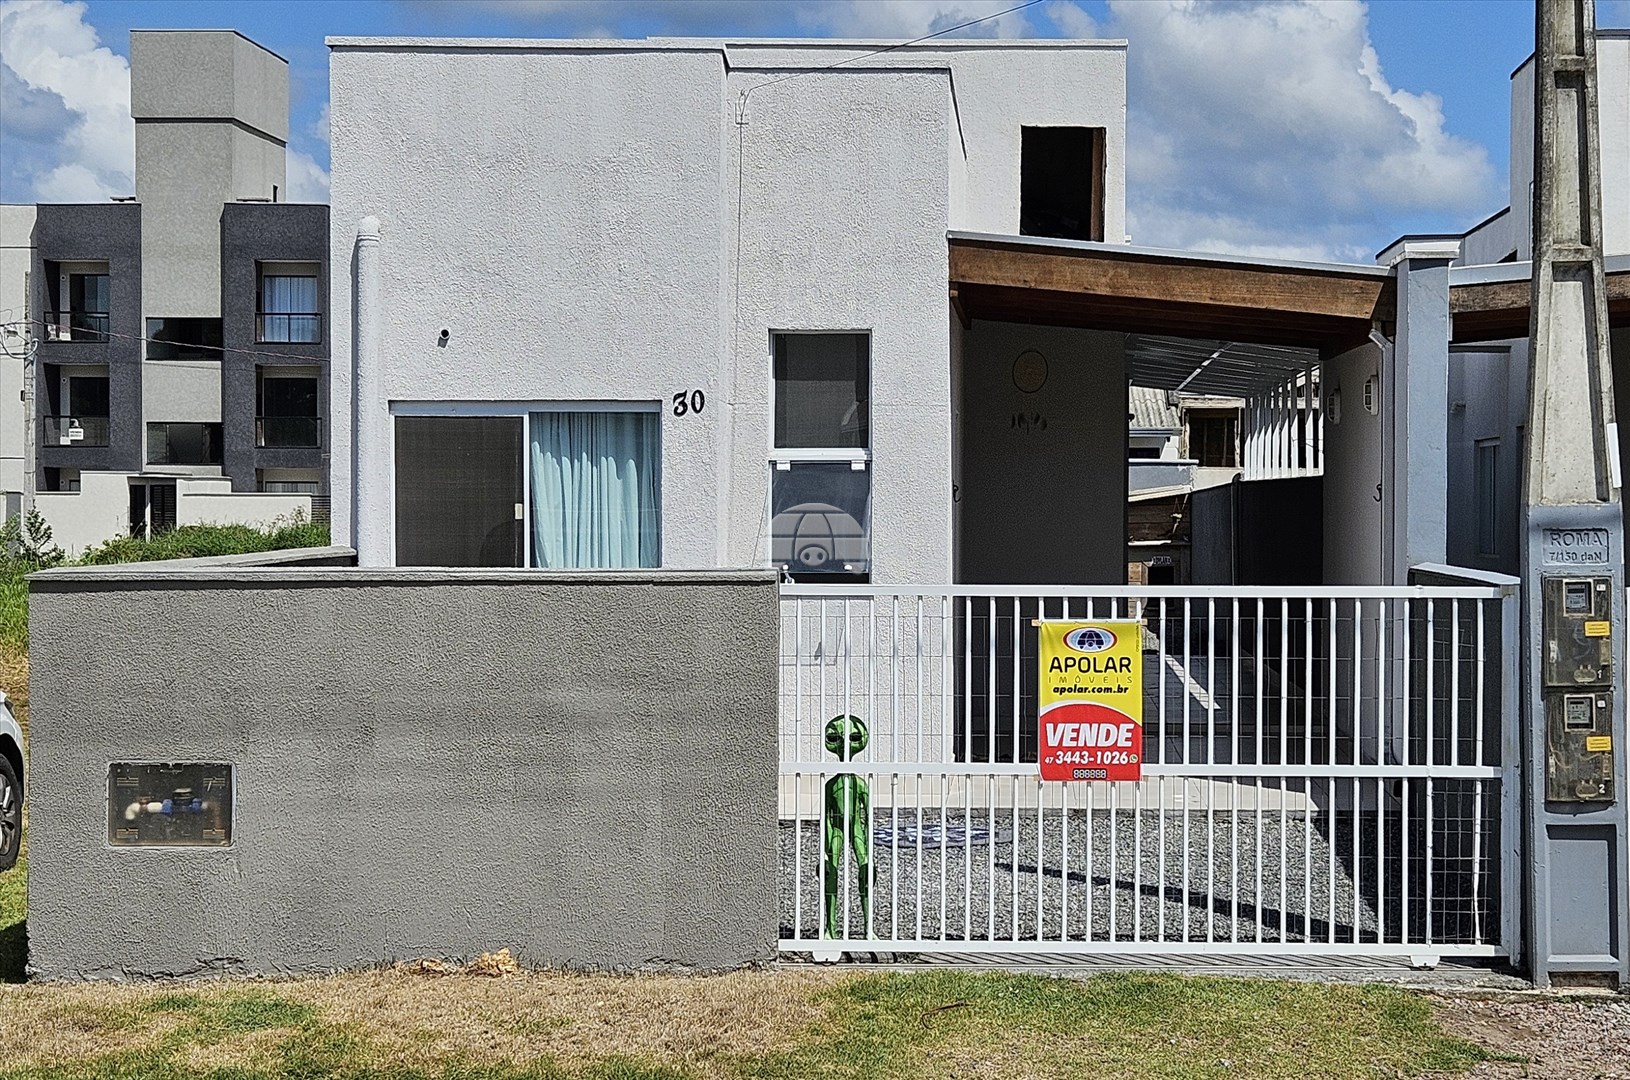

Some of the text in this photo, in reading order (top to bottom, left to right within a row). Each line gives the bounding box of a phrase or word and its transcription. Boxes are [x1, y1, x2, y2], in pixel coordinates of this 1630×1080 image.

[673, 389, 705, 417] 30
[1549, 532, 1603, 546] ROMA
[1580, 551, 1602, 561] daN
[1049, 656, 1132, 673] APOLAR
[1053, 684, 1129, 695] apolar.com.br
[1045, 723, 1135, 747] VENDE
[1045, 750, 1128, 764] 47 3443-1026
[1599, 783, 1606, 794] 2
